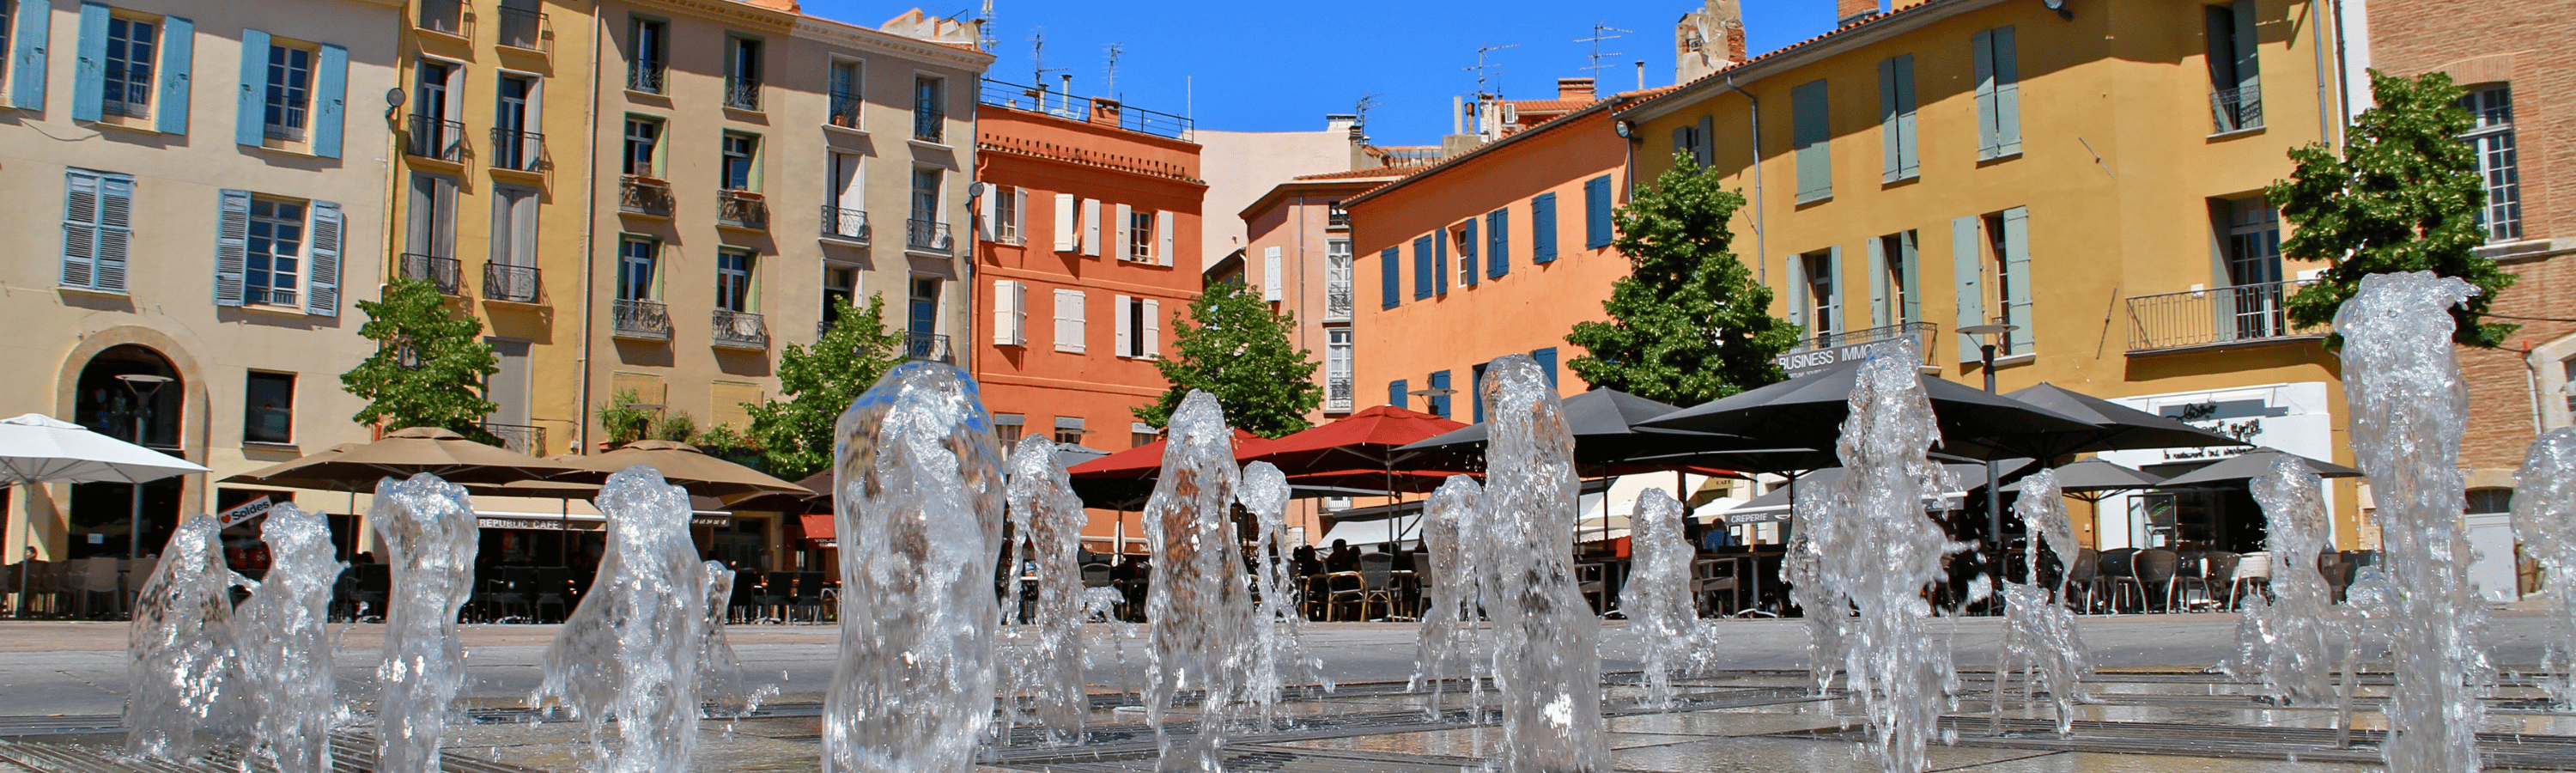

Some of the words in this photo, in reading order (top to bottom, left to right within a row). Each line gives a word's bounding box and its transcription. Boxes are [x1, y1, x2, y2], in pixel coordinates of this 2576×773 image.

[1778, 350, 1834, 370] BUSINESS
[1842, 343, 1875, 362] IMMO
[232, 501, 270, 520] Soldes
[479, 518, 528, 528] REPUBLIC
[1730, 513, 1768, 523] CREPERIE
